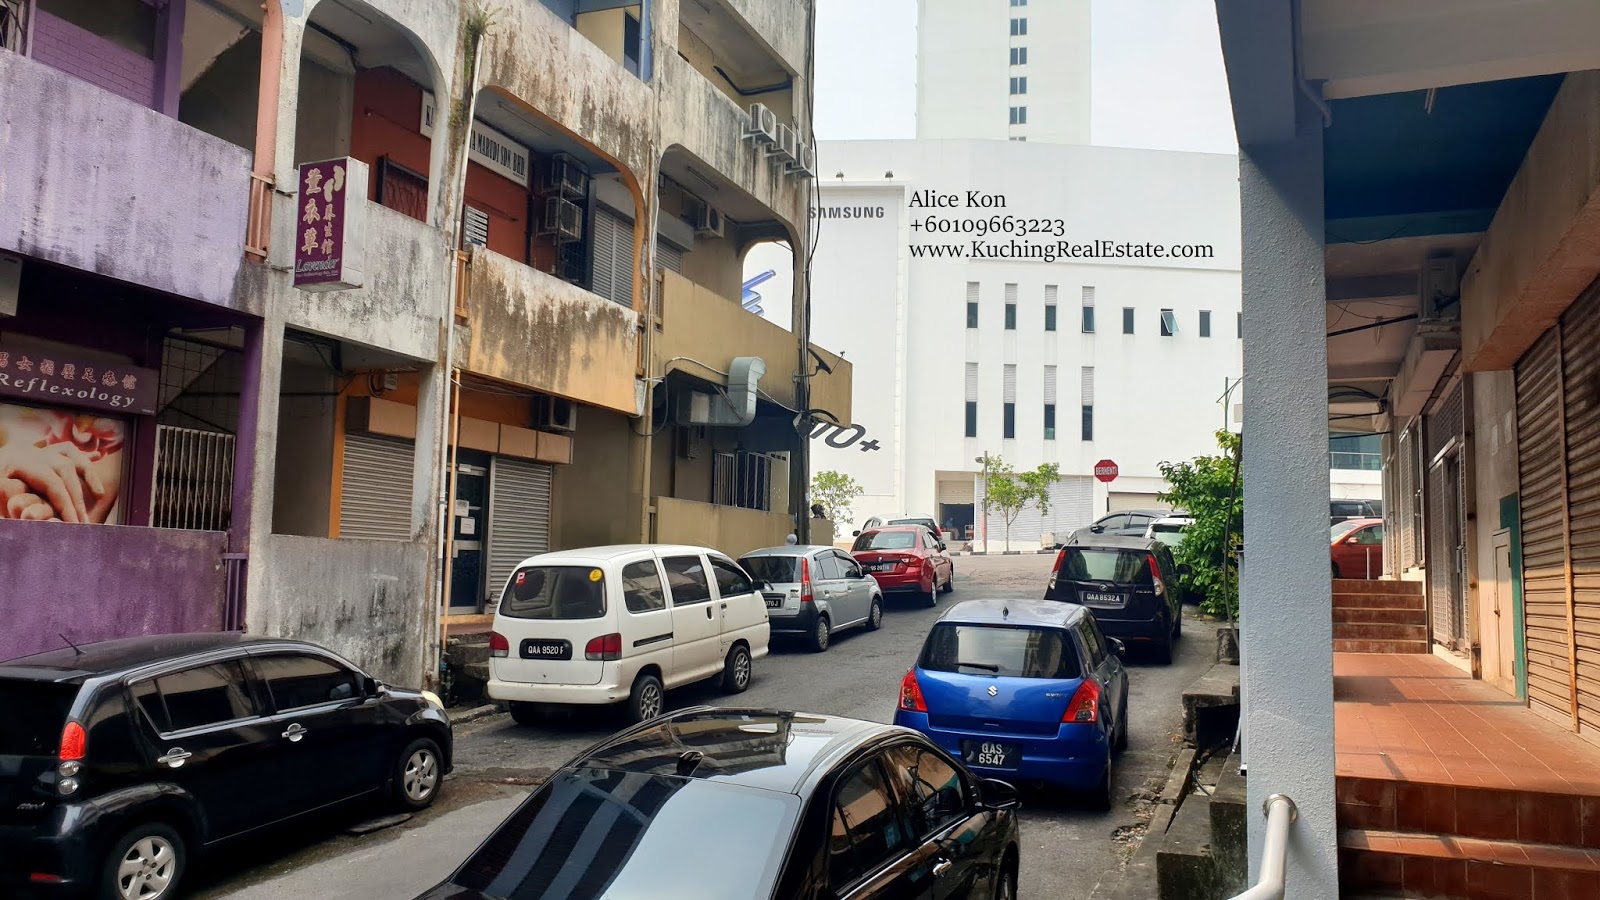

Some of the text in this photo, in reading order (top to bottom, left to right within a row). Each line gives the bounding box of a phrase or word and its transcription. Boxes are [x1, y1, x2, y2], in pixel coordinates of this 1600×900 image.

[810, 206, 885, 219] SAMSUNG
[295, 254, 340, 273] Lavender
[0, 373, 135, 408] Reflexology
[1095, 466, 1118, 475] BERHENTI
[528, 645, 564, 655] QAA 9520 F
[981, 743, 1003, 755] QAS
[978, 753, 1006, 766] 6547
